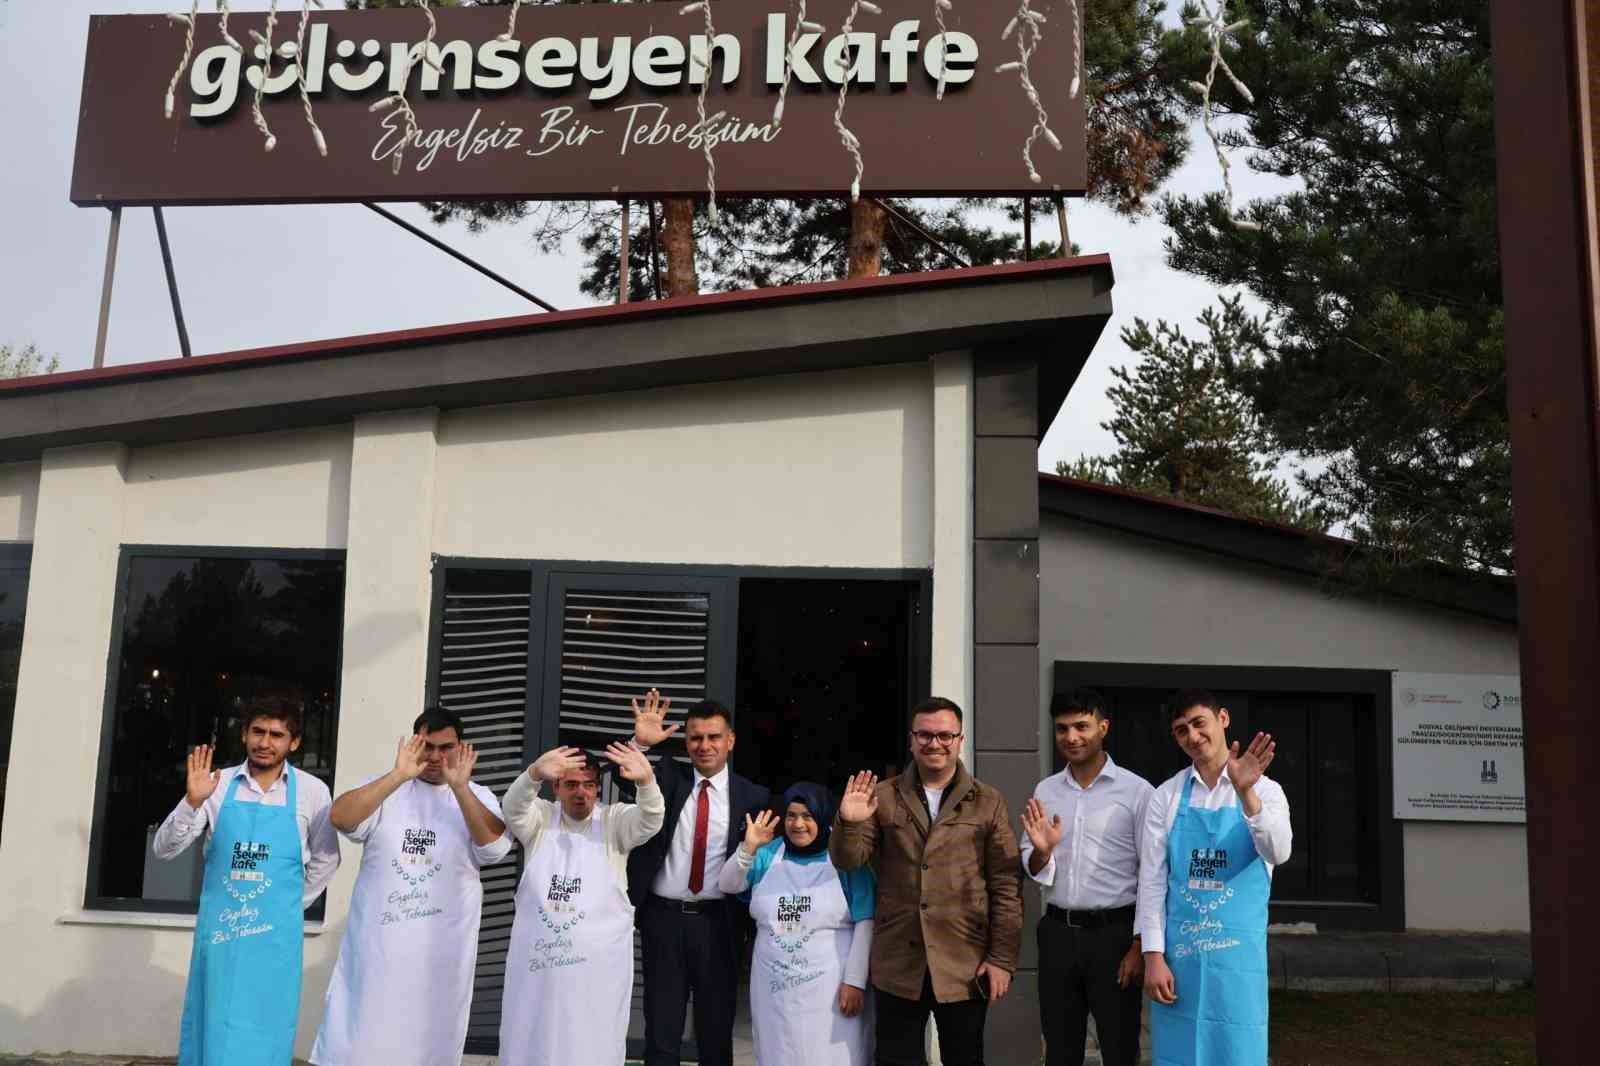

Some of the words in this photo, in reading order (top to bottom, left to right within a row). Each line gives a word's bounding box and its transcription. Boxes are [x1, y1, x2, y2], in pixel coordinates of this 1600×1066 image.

[766, 13, 979, 84] kafe
[371, 106, 523, 171] Engelsiz
[527, 105, 604, 156] Bir
[614, 102, 783, 155] Tebessüm
[402, 840, 426, 855] kafe
[406, 838, 436, 848] seyen
[232, 855, 257, 870] kafe
[1189, 862, 1216, 879] kafe
[547, 887, 570, 902] kafe
[777, 908, 801, 922] kafe
[780, 904, 811, 913] seyen
